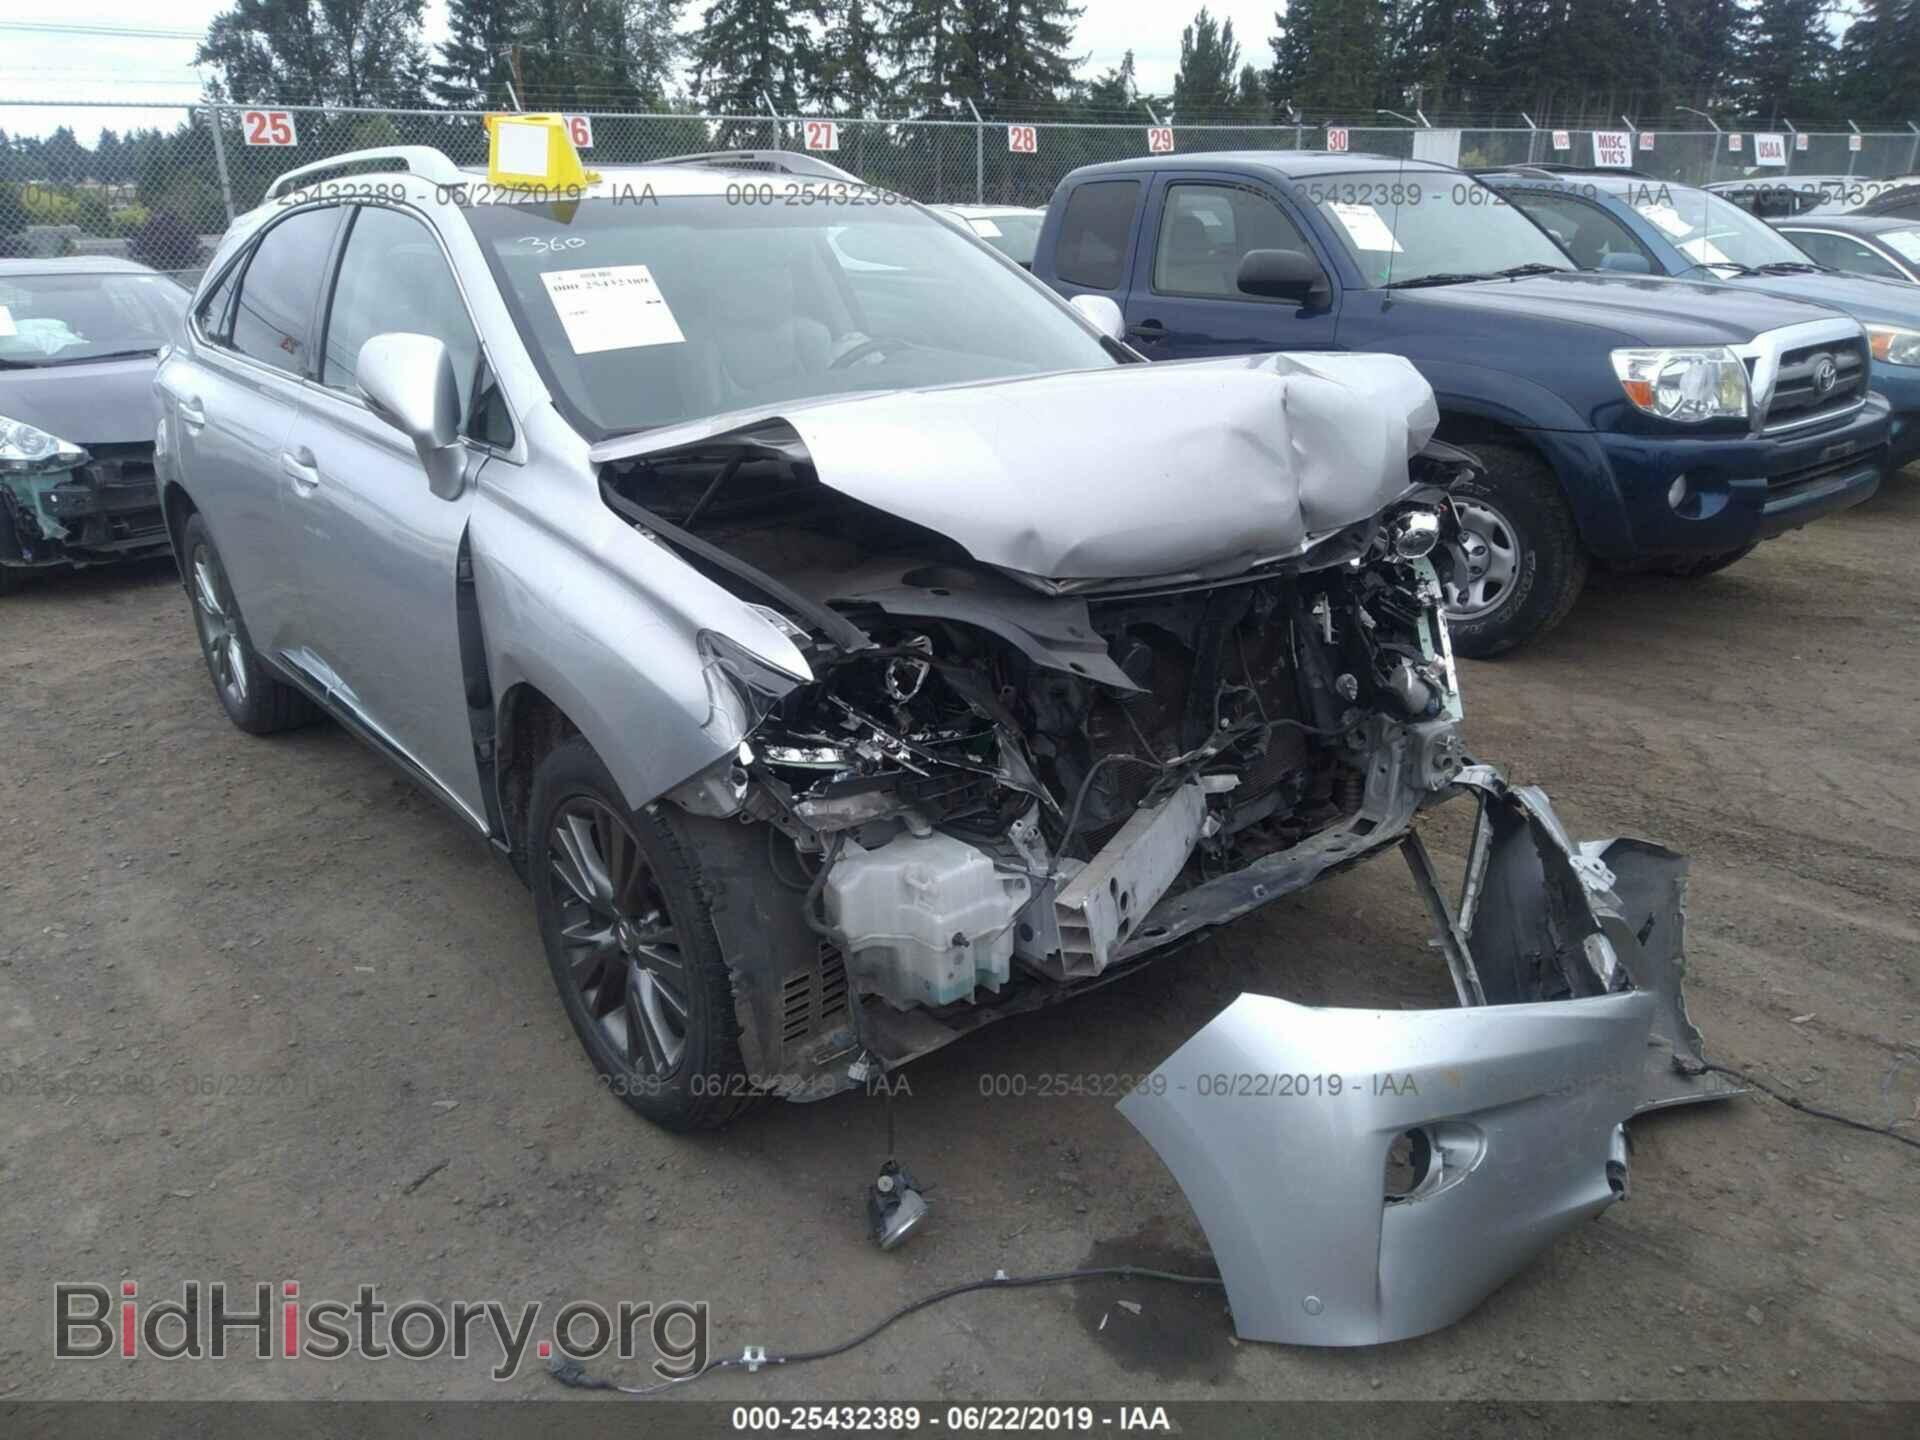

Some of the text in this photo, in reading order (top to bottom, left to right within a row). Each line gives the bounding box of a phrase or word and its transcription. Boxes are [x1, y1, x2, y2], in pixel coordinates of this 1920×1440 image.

[246, 111, 291, 145] 25
[563, 117, 589, 146] 6
[808, 123, 832, 148] 27
[1011, 127, 1035, 150] 28
[1151, 129, 1172, 150] 29
[1329, 131, 1346, 150] 30
[1598, 135, 1626, 149] MISC.
[1601, 151, 1625, 164] VIC'S
[1760, 142, 1782, 158] USAA
[518, 237, 587, 253] 360
